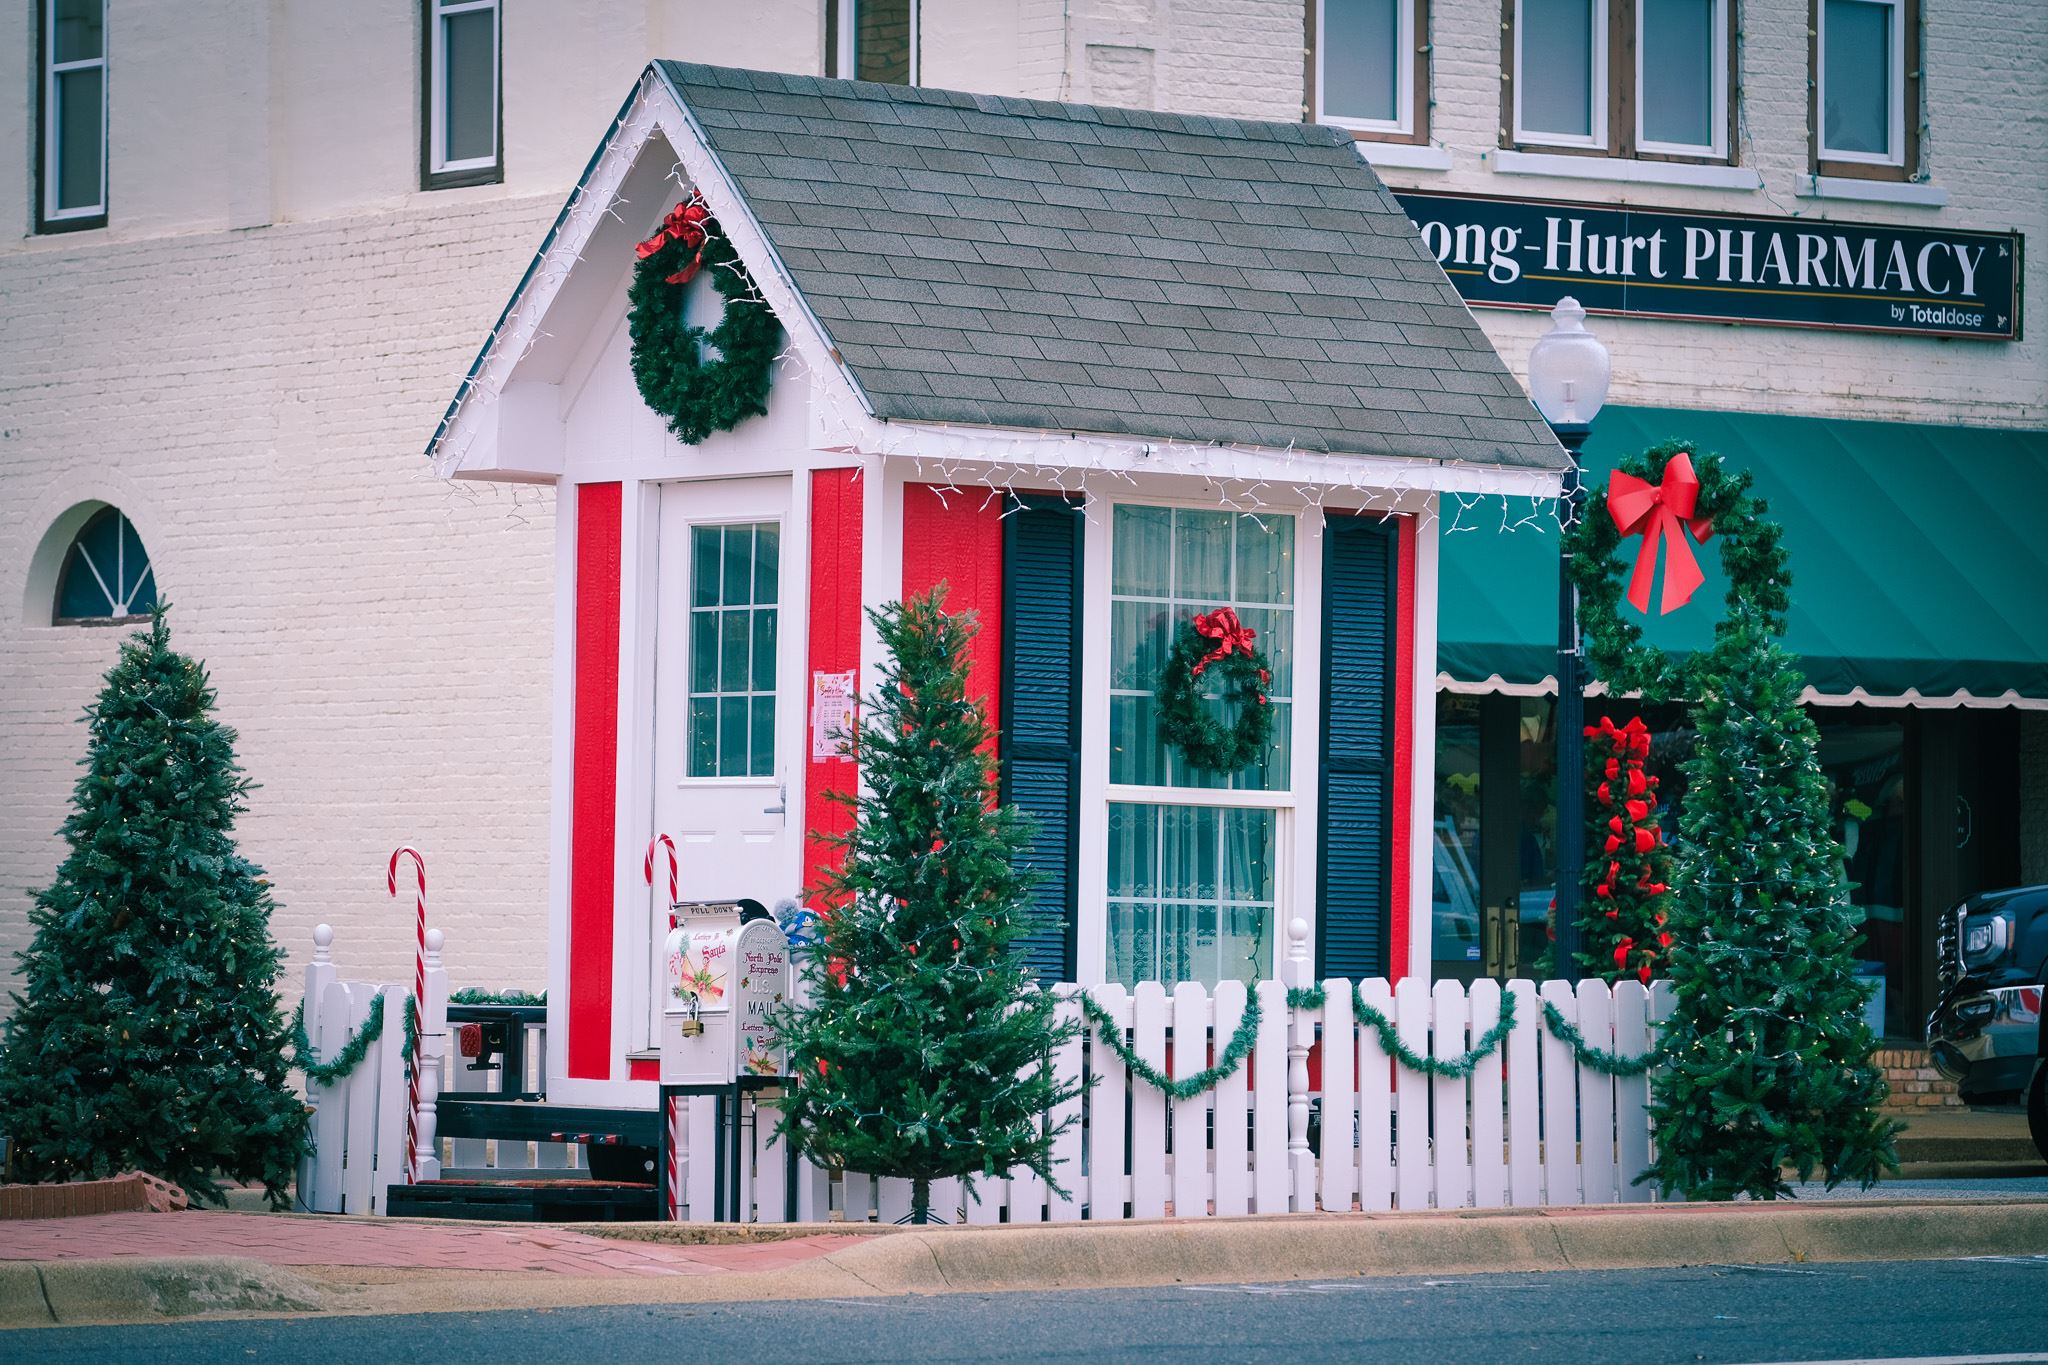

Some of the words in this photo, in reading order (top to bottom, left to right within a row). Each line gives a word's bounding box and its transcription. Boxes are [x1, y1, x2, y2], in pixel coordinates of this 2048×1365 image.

[1410, 217, 1667, 284] ong-Hurt
[1683, 227, 1986, 296] PHARMACY
[1891, 304, 1905, 321] by
[1910, 305, 1983, 327] Totaldose
[702, 944, 726, 964] Santa
[742, 951, 763, 964] North
[766, 952, 783, 965] Pole
[748, 964, 779, 978] Express
[750, 979, 773, 994] U.S.
[747, 1000, 777, 1016] MAIL
